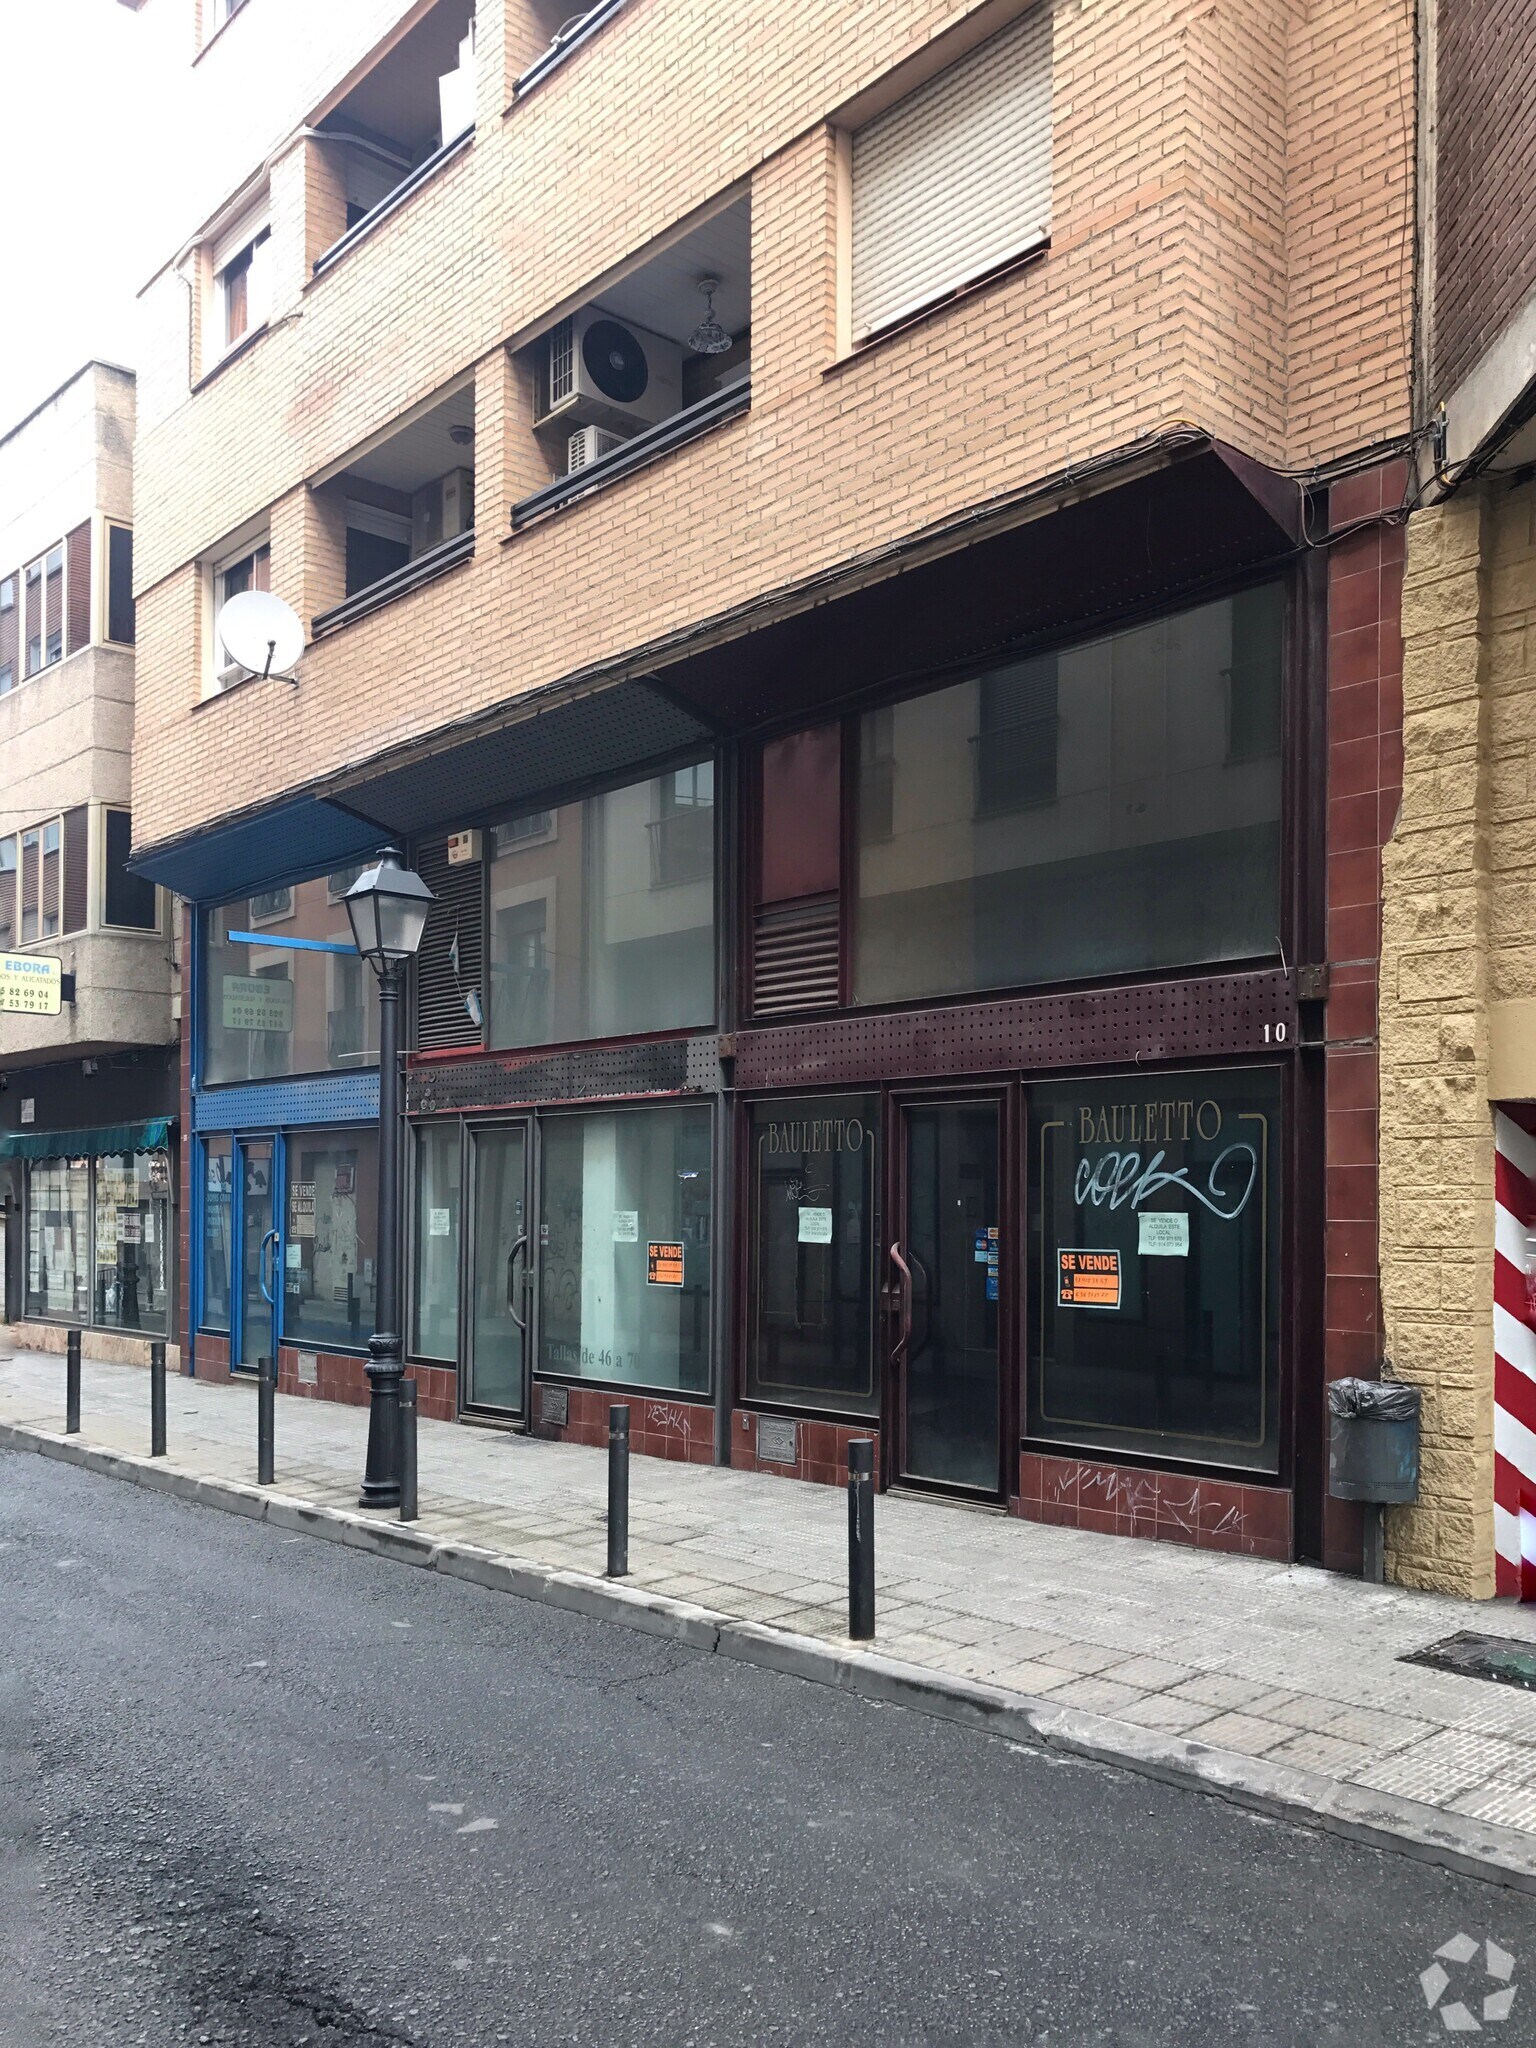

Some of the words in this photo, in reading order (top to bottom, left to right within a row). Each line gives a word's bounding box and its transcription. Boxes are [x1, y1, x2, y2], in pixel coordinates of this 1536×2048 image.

[5, 960, 51, 975] EBORA
[9, 987, 20, 996] 82
[23, 989, 35, 998] 69
[38, 990, 49, 999] 04
[9, 999, 20, 1008] 53
[23, 1000, 35, 1009] 79
[39, 1001, 49, 1010] 17
[1263, 1022, 1286, 1043] 10
[1079, 1099, 1222, 1145] BAULETTO
[768, 1118, 864, 1154] BAULETTO
[299, 1184, 315, 1197] VENDE
[649, 1245, 658, 1258] SE
[659, 1246, 682, 1259] VENDE
[1061, 1254, 1076, 1270] SE
[1078, 1254, 1118, 1271] VENDE
[546, 1343, 577, 1361] Tallas
[581, 1347, 595, 1365] de
[598, 1349, 612, 1367] 46
[616, 1355, 623, 1368] a
